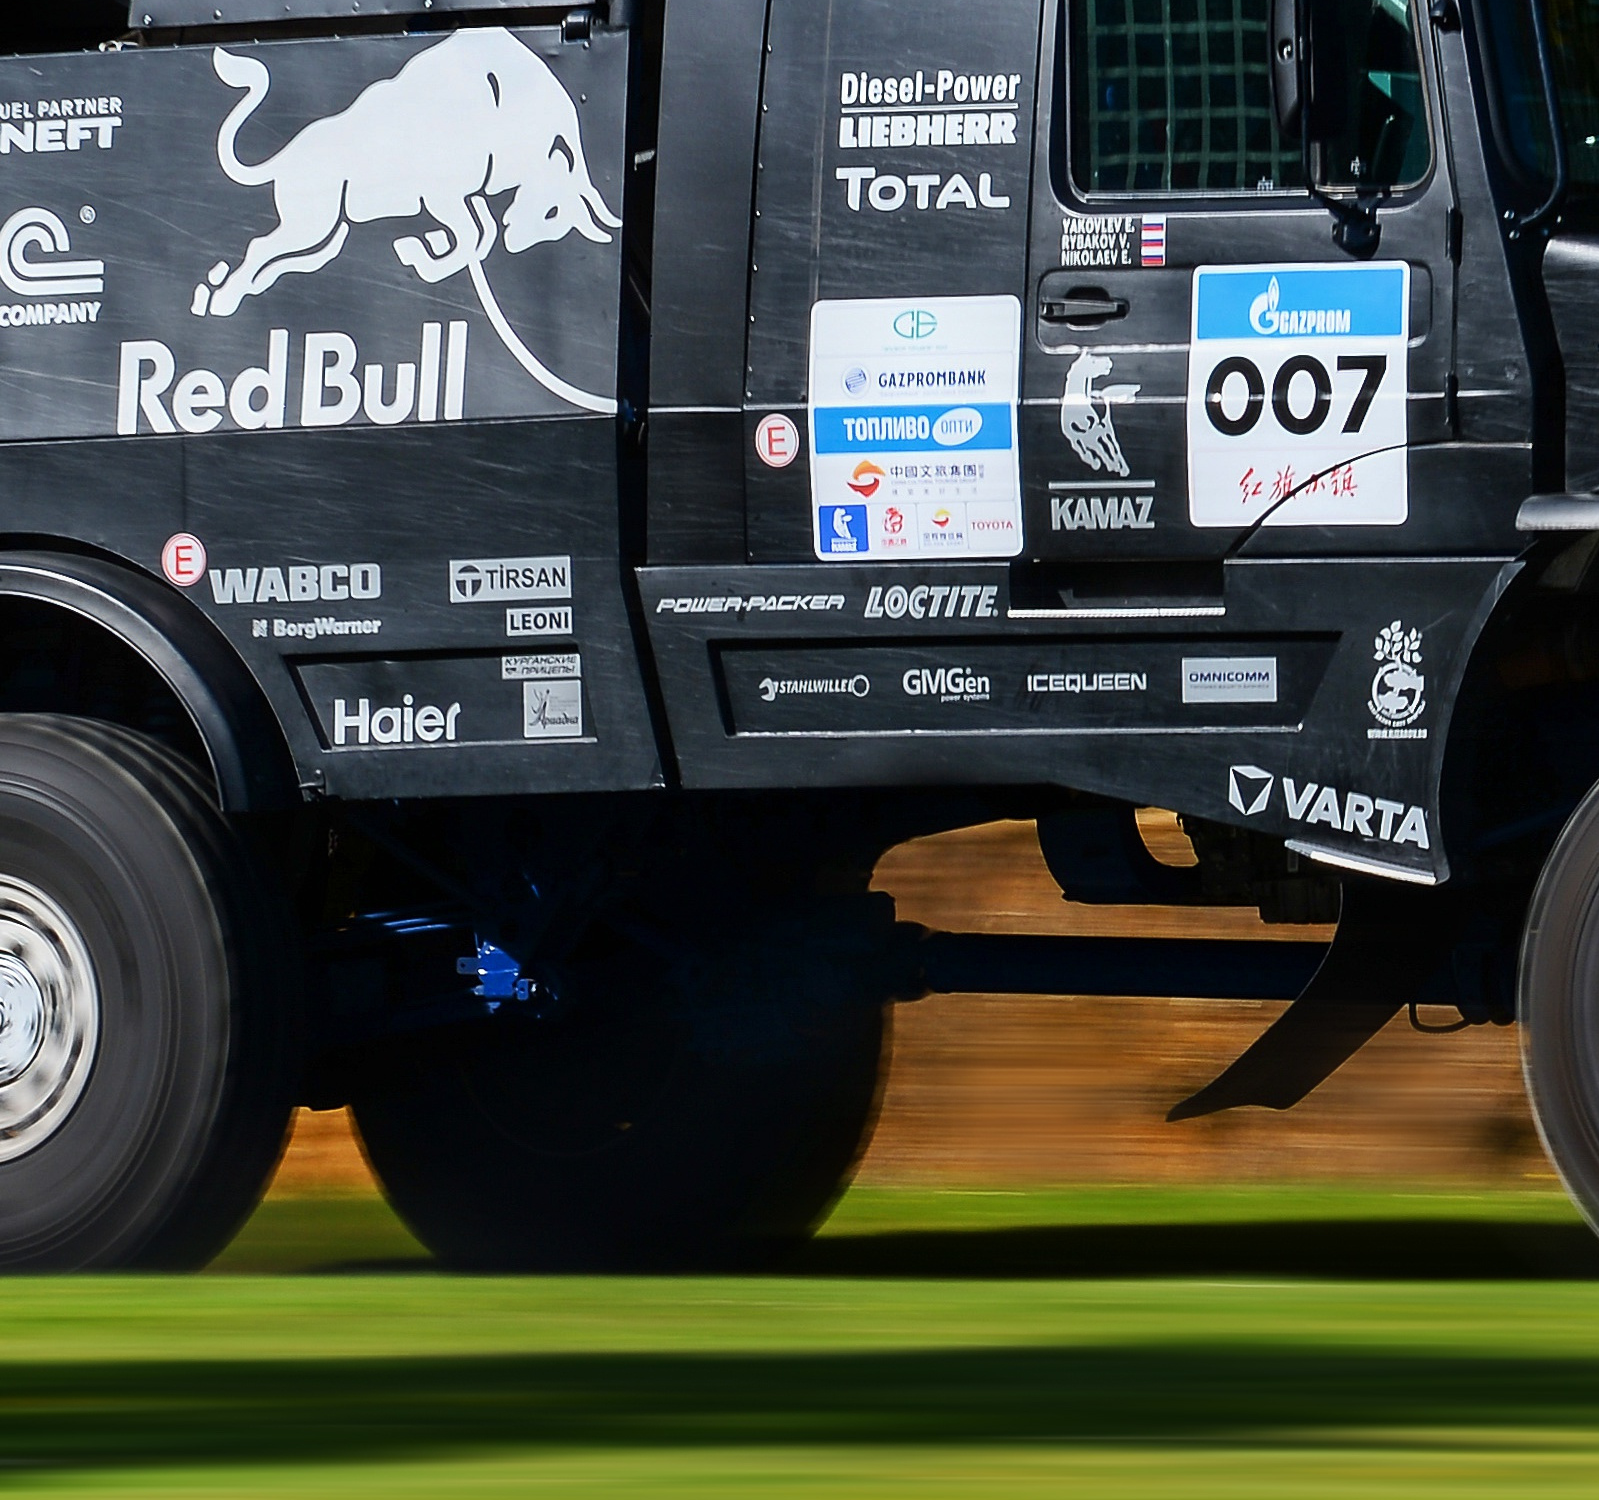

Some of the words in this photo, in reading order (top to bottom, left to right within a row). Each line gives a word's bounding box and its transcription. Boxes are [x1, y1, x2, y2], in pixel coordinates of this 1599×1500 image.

[841, 70, 1020, 104] Diesel-Power
[38, 97, 122, 117] PARTNER
[839, 113, 1017, 148] LIEBHERR
[836, 167, 1010, 211] TOTAL
[1062, 216, 1122, 234] YAKOVLEV
[1062, 233, 1116, 250] RYBAKOV
[1061, 249, 1118, 266] NIKOLAEV
[1279, 309, 1351, 334] GAZPROM
[117, 328, 289, 435] Red
[300, 320, 468, 427] Bull
[878, 370, 986, 387] GAZPROMBANK
[1205, 355, 1387, 436] 007
[843, 415, 930, 441] ТОПЛИВО
[940, 419, 973, 435] ОПТИ
[767, 426, 788, 456] E
[1051, 495, 1155, 530] KAMAZ
[971, 521, 1013, 531] TOYOTA
[208, 563, 382, 604] WABCO
[273, 616, 382, 640] BorgWarner
[510, 612, 569, 631] LEONI
[902, 667, 990, 696] GMGen
[1027, 672, 1147, 693] ICEQUEEN
[1189, 672, 1270, 682] OMNICOMM
[941, 695, 961, 703] power
[334, 694, 461, 745] Haier
[1282, 776, 1430, 850] VARTA
